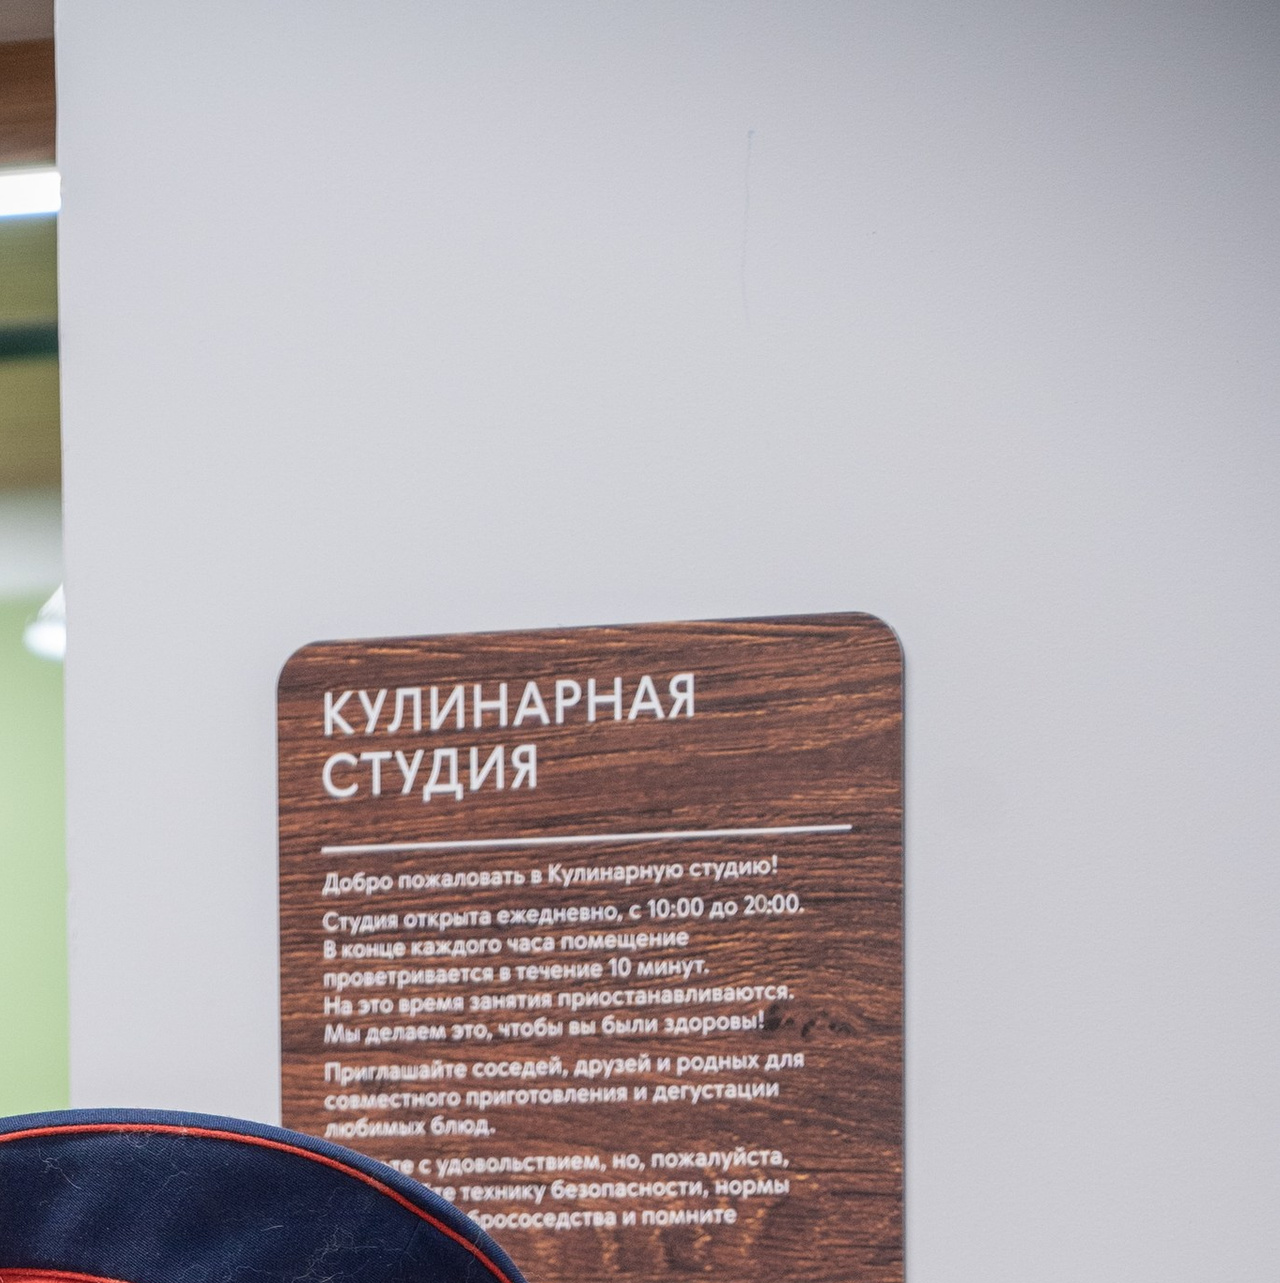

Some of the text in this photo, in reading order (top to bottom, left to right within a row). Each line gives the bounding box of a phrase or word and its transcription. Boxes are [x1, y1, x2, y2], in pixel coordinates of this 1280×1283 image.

[324, 673, 695, 736] КУЛИНАРНАЯ
[322, 744, 537, 802] СТУДИЯ
[322, 855, 778, 896] Добро пожаловать в Кулинарную студию!
[322, 893, 805, 935] Студия открыта ежедневно, с 10:00 до 20:00.
[323, 931, 689, 960] В конце каждого часа помещение
[323, 957, 709, 991] проветривается в течение 10 минут.
[324, 985, 794, 1017] На это время занятия приостанавливаются.
[324, 1010, 764, 1045] Мы делаем это, чтобы вы были здоровы!
[324, 1052, 804, 1085] Приглашайте соседей, друзей и родных для
[324, 1081, 779, 1110] совместного приготовления и дегустации
[324, 1115, 496, 1138] любимых блюд.
[419, 1158, 432, 1175] с
[436, 1154, 607, 1178] удовольствием,
[612, 1153, 645, 1171] но,
[651, 1146, 789, 1172] пожалуйста,
[462, 1183, 546, 1204] технику
[551, 1179, 709, 1199] безопасности,
[715, 1178, 789, 1199] нормы
[467, 1207, 737, 1232] брососедства и помните
